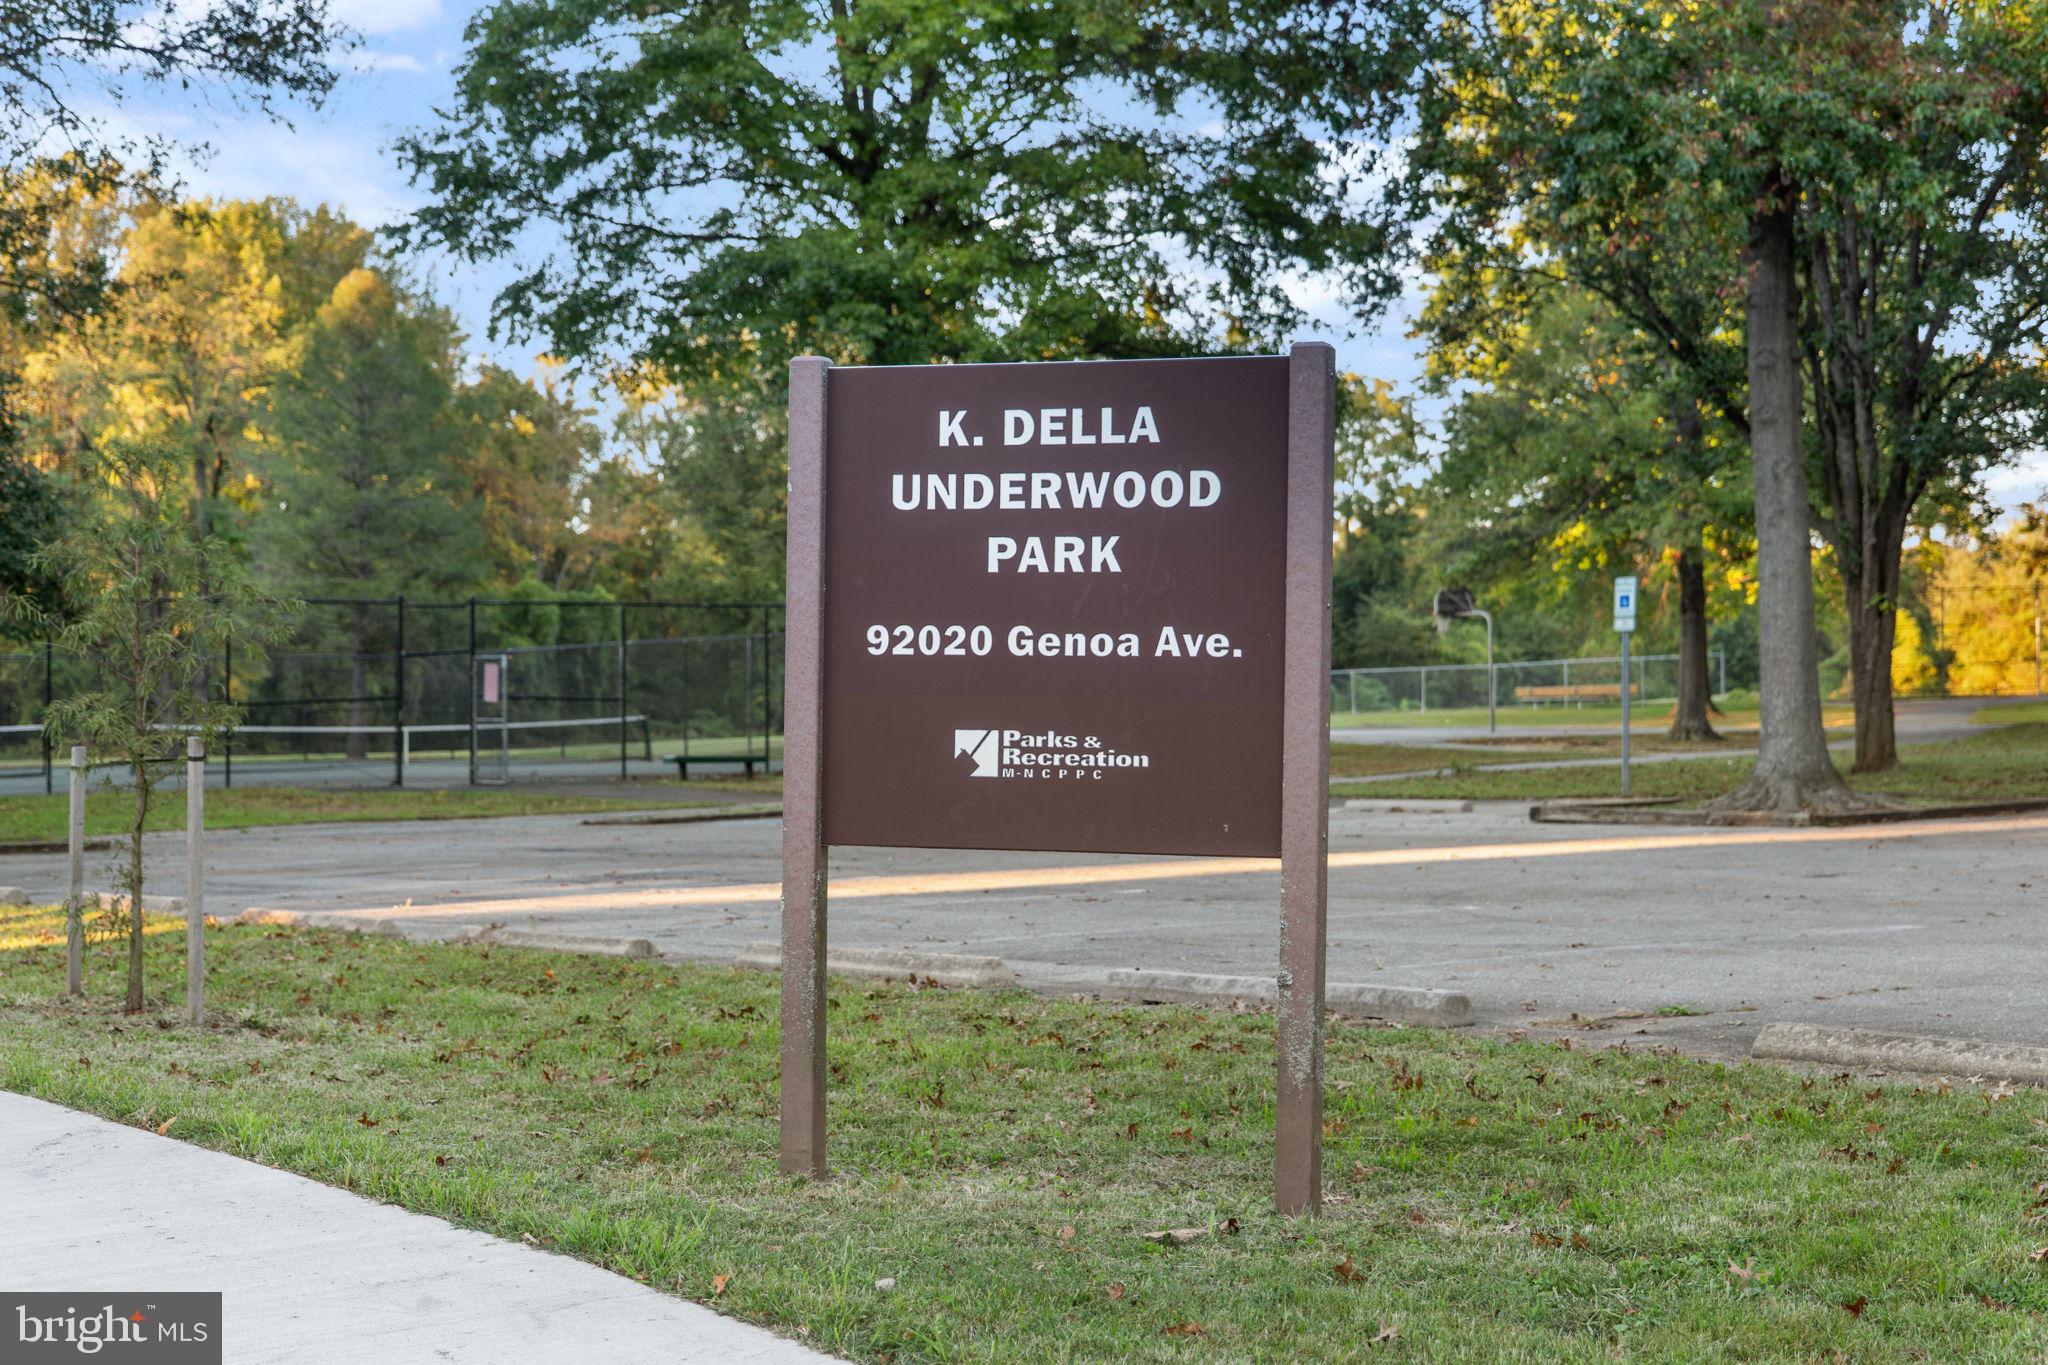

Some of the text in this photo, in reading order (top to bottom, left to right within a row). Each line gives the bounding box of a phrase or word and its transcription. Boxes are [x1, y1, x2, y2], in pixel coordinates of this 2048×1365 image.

[938, 406, 1161, 447] K. DELLA
[892, 469, 1221, 511] UNDERWOOD
[987, 535, 1122, 573] PARK
[866, 624, 1242, 658] 92020 Genoa Ave.
[1002, 729, 1102, 749] Parks &
[1002, 747, 1149, 768] Recreation
